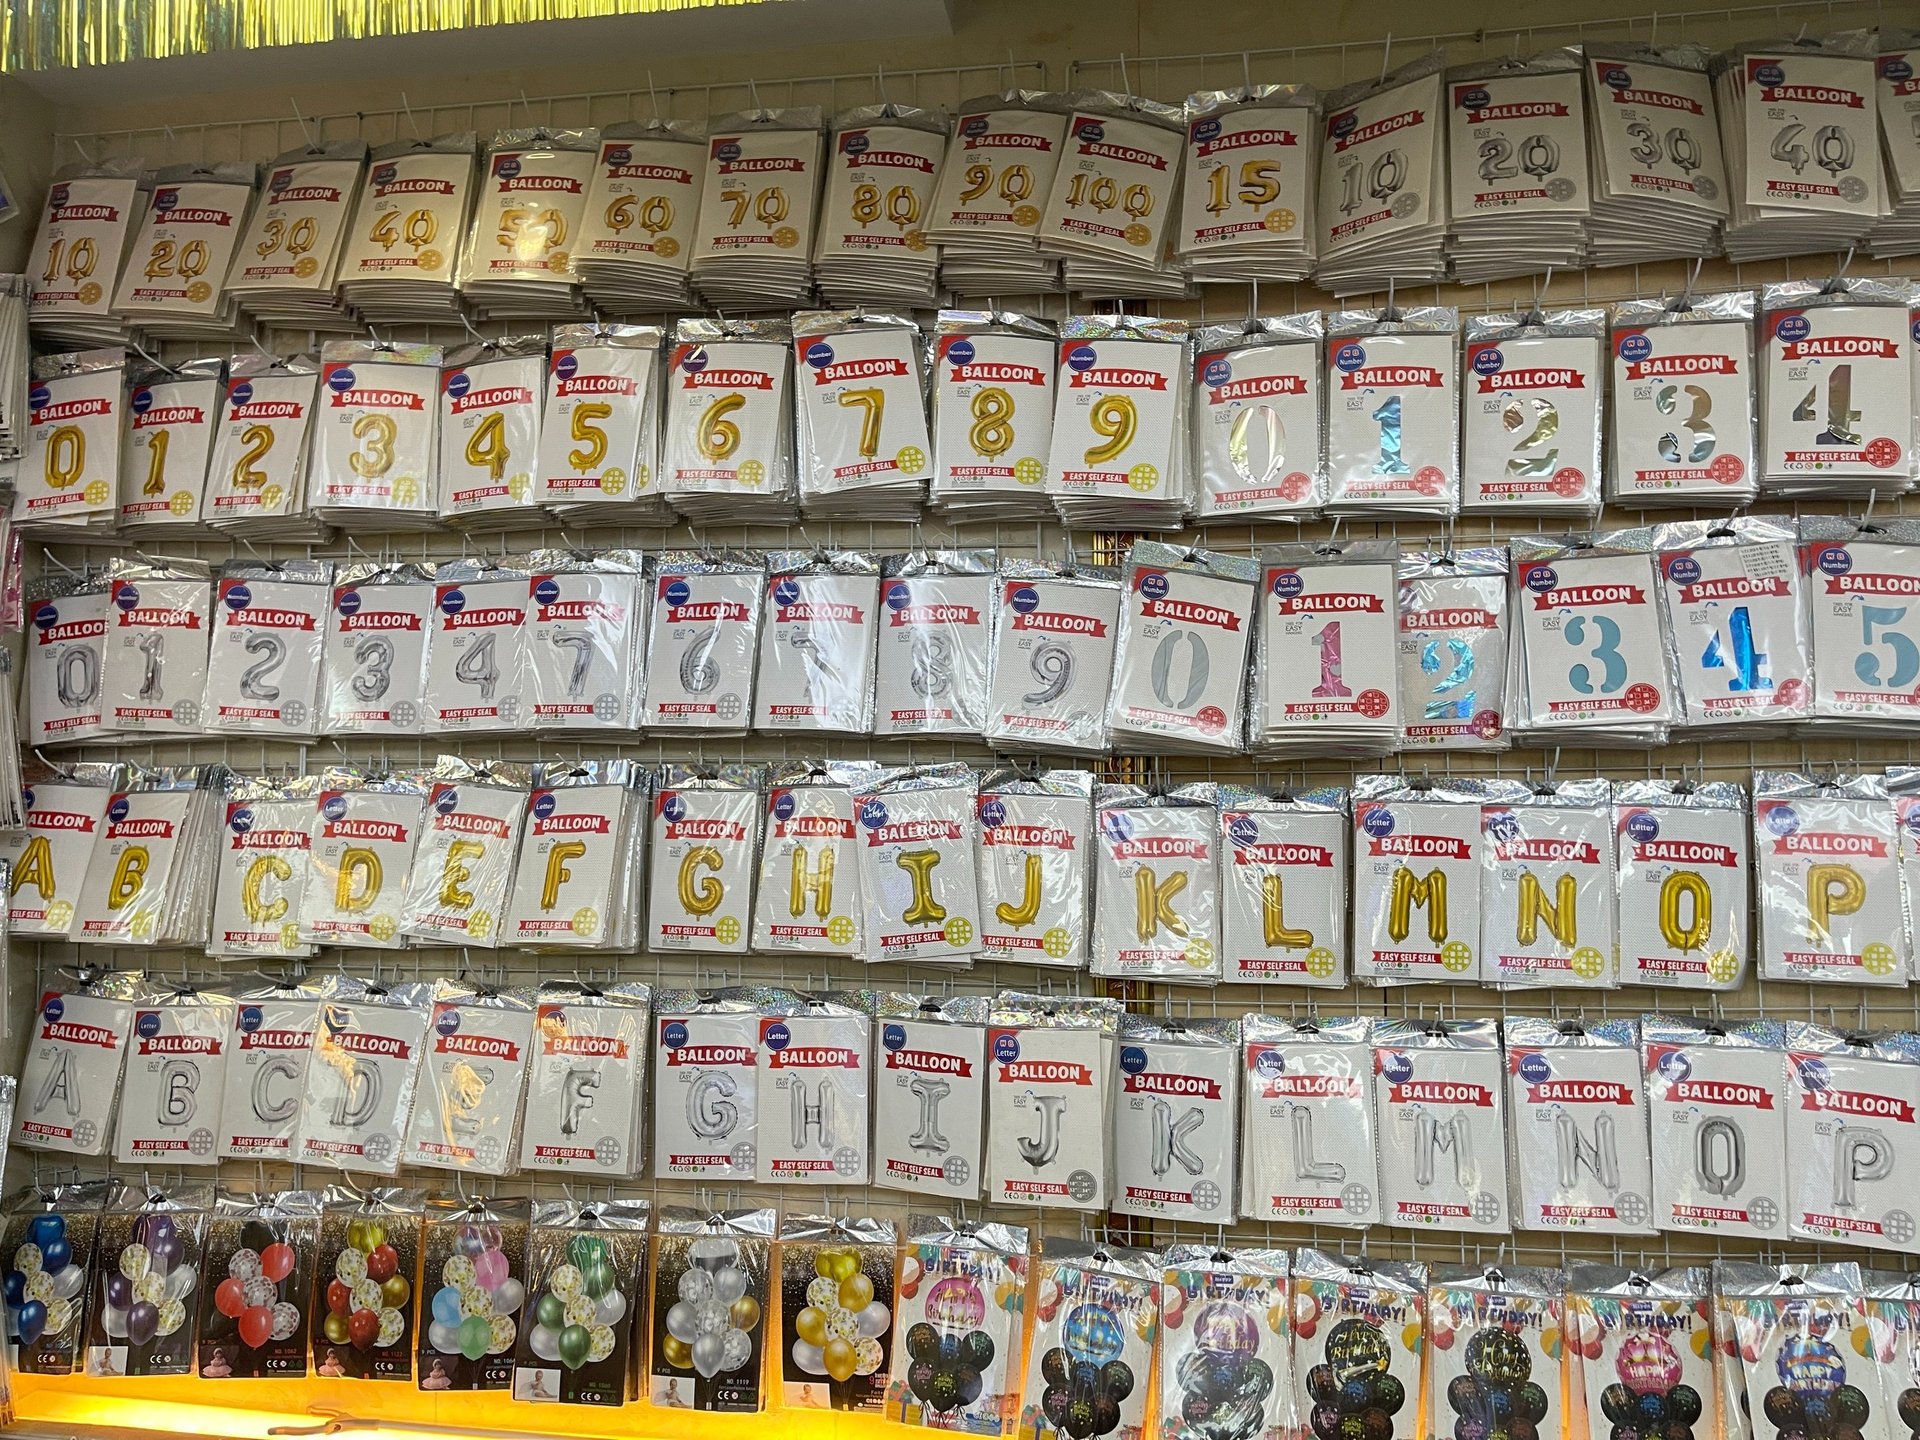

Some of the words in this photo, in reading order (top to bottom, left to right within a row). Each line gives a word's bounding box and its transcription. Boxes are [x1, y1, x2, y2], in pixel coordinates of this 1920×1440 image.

[1623, 90, 1692, 110] BALLOON
[1774, 88, 1852, 103] BALLOON
[1479, 104, 1556, 119] BALLOON
[976, 136, 1042, 148] BALLOON
[1208, 132, 1285, 151] BALLOON
[1090, 144, 1158, 165] BALLOON
[1771, 124, 1854, 178] 40
[729, 159, 794, 171] BALLOON
[858, 154, 924, 167] BALLOON
[1477, 134, 1561, 186] 20
[619, 167, 683, 179] BALLOON
[278, 188, 333, 200] BALLOON
[384, 181, 445, 194] BALLOON
[1206, 160, 1281, 218] 15
[1066, 173, 1155, 222] 100
[57, 207, 111, 221] BALLOON
[721, 187, 791, 229] 70
[852, 185, 921, 231] 80
[605, 195, 675, 237] 60
[370, 209, 439, 251] 40
[1204, 228, 1222, 237] EASY
[1223, 226, 1241, 234] SELF
[1243, 223, 1260, 231] SEAL
[1781, 328, 1807, 336] Number
[1623, 347, 1648, 356] Number
[1797, 341, 1884, 354] BALLOON
[1340, 358, 1362, 366] Number
[1477, 361, 1500, 369] Number
[1640, 358, 1723, 374] BALLOON
[825, 362, 896, 379] BALLOON
[962, 367, 1034, 379] BALLOON
[1354, 370, 1431, 384] BALLOON
[1789, 370, 1807, 378] EASY
[565, 379, 628, 391] BALLOON
[695, 374, 762, 385] BALLOON
[1082, 372, 1155, 385] BALLOON
[1491, 372, 1571, 387] BALLOON
[1221, 378, 1294, 398] BALLOON
[460, 389, 522, 408] BALLOON
[1792, 364, 1862, 445] 4
[141, 409, 194, 424] BALLOON
[239, 404, 294, 417] BALLOON
[839, 387, 884, 460] 7
[970, 387, 1015, 462] 8
[1084, 394, 1138, 467] 9
[1656, 385, 1716, 463] 3
[569, 402, 612, 472] 5
[1372, 396, 1410, 474] 1
[1502, 398, 1559, 477] 2
[465, 411, 510, 481] 4
[233, 424, 274, 491] 2
[1795, 452, 1815, 461] EASY
[1818, 452, 1838, 461] SELF
[1839, 452, 1860, 461] SEAL
[841, 466, 858, 476] EASY
[859, 464, 875, 474] SELF
[877, 462, 892, 471] SEAL
[1645, 471, 1665, 479] EASY
[1668, 470, 1685, 479] SELF
[1688, 469, 1706, 478] SEAL
[552, 480, 567, 488] EASY
[569, 480, 582, 488] SELF
[1069, 472, 1086, 481] EASY
[1088, 473, 1104, 481] SELF
[1106, 474, 1122, 482] SEAL
[1489, 483, 1508, 492] EASY
[1510, 483, 1529, 492] SELF
[1531, 482, 1548, 491] SEAL
[1530, 578, 1554, 586] Number
[1692, 579, 1776, 598] BALLOON
[1143, 585, 1166, 595] Number
[1548, 587, 1631, 604] BALLOON
[1292, 597, 1371, 610] BALLOON
[238, 611, 305, 625] BALLOON
[453, 611, 517, 625] BALLOON
[677, 606, 739, 618] BALLOON
[1154, 601, 1230, 624] BALLOON
[1407, 612, 1484, 627] BALLOON
[1024, 615, 1095, 631] BALLOON
[1702, 606, 1772, 691] 4
[1854, 605, 1919, 687] 5
[1311, 621, 1352, 697] 1
[1564, 615, 1627, 693] 3
[456, 631, 499, 699] 4
[1420, 639, 1475, 719] 2
[1294, 704, 1312, 713] EASY
[1314, 704, 1331, 712] SELF
[1334, 703, 1352, 712] SEAL
[1558, 702, 1579, 711] EASY
[1581, 701, 1600, 710] SELF
[1602, 700, 1621, 709] SEAL
[1411, 727, 1429, 735] EASY
[1431, 727, 1449, 735] SELF
[1451, 726, 1468, 734] SEAL
[115, 822, 167, 835] BALLOON
[332, 822, 398, 837] BALLOON
[542, 818, 600, 832] BALLOON
[675, 822, 737, 835] BALLOON
[784, 819, 846, 833] BALLOON
[1368, 819, 1390, 827] Letter
[1122, 842, 1196, 854] BALLOON
[1381, 838, 1458, 853] BALLOON
[1787, 837, 1872, 851] BALLOON
[1646, 844, 1724, 861] BALLOON
[541, 839, 586, 911] F
[678, 845, 724, 919] G
[789, 848, 834, 921] H
[896, 849, 946, 927] I
[996, 853, 1042, 930] J
[1263, 873, 1313, 950] L
[1388, 866, 1448, 946] M
[1807, 863, 1866, 945] P
[1381, 952, 1398, 961] EASY
[1400, 952, 1416, 962] SELF
[1418, 953, 1436, 962] SEAL
[1793, 954, 1811, 963] EASY
[1814, 955, 1832, 963] SELF
[1835, 956, 1855, 965] SEAL
[51, 1024, 108, 1042] BALLOON
[149, 1039, 211, 1051] BALLOON
[678, 1049, 746, 1061] BALLOON
[779, 1051, 848, 1063] BALLOON
[997, 1049, 1016, 1058] Letter
[896, 1054, 961, 1071] BALLOON
[1522, 1064, 1547, 1072] Letter
[1009, 1065, 1080, 1079] BALLOON
[1135, 1077, 1209, 1093] BALLOON
[1401, 1085, 1480, 1100] BALLOON
[1539, 1085, 1620, 1098] BALLOON
[1678, 1084, 1761, 1102] BALLOON
[1815, 1092, 1902, 1115] BALLOON
[1017, 1095, 1067, 1167] J
[1151, 1099, 1204, 1177] K
[779, 1162, 796, 1170] EASY
[798, 1162, 812, 1170] SELF
[814, 1161, 829, 1170] SEAL
[1833, 1124, 1895, 1209] P
[1012, 1183, 1029, 1192] EASY
[1031, 1184, 1046, 1192] SELF
[1048, 1185, 1063, 1193] SEAL
